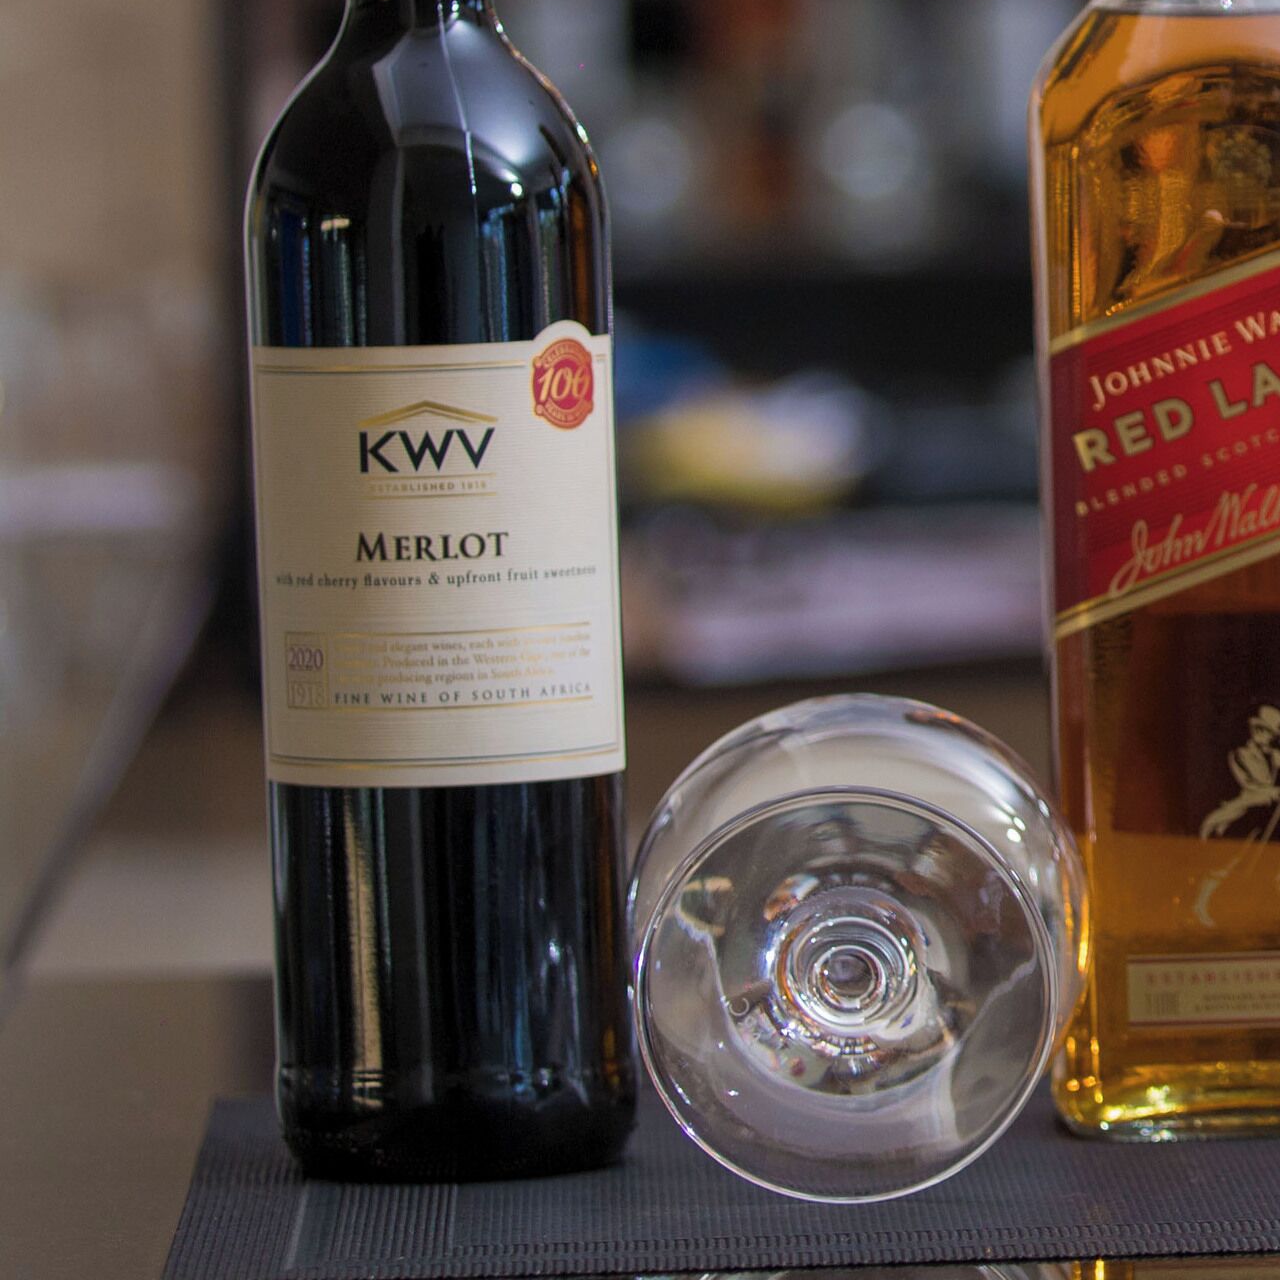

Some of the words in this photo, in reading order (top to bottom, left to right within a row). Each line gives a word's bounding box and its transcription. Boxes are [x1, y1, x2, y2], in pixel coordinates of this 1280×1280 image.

[1089, 330, 1233, 412] JOHNNIE
[359, 427, 496, 474] KWV
[1071, 395, 1196, 472] RED
[1074, 463, 1189, 517] BLENDED
[355, 531, 510, 563] MERLOT
[317, 573, 358, 590] cherry
[363, 572, 422, 586] flavours
[427, 572, 440, 585] &
[447, 570, 501, 588] upfront
[507, 568, 538, 581] fruit
[288, 647, 324, 671] 2020
[334, 692, 371, 705] FINE
[380, 691, 428, 705] WINE
[438, 690, 461, 703] OF
[471, 686, 531, 701] SOUTH
[539, 681, 592, 697] AFRICA
